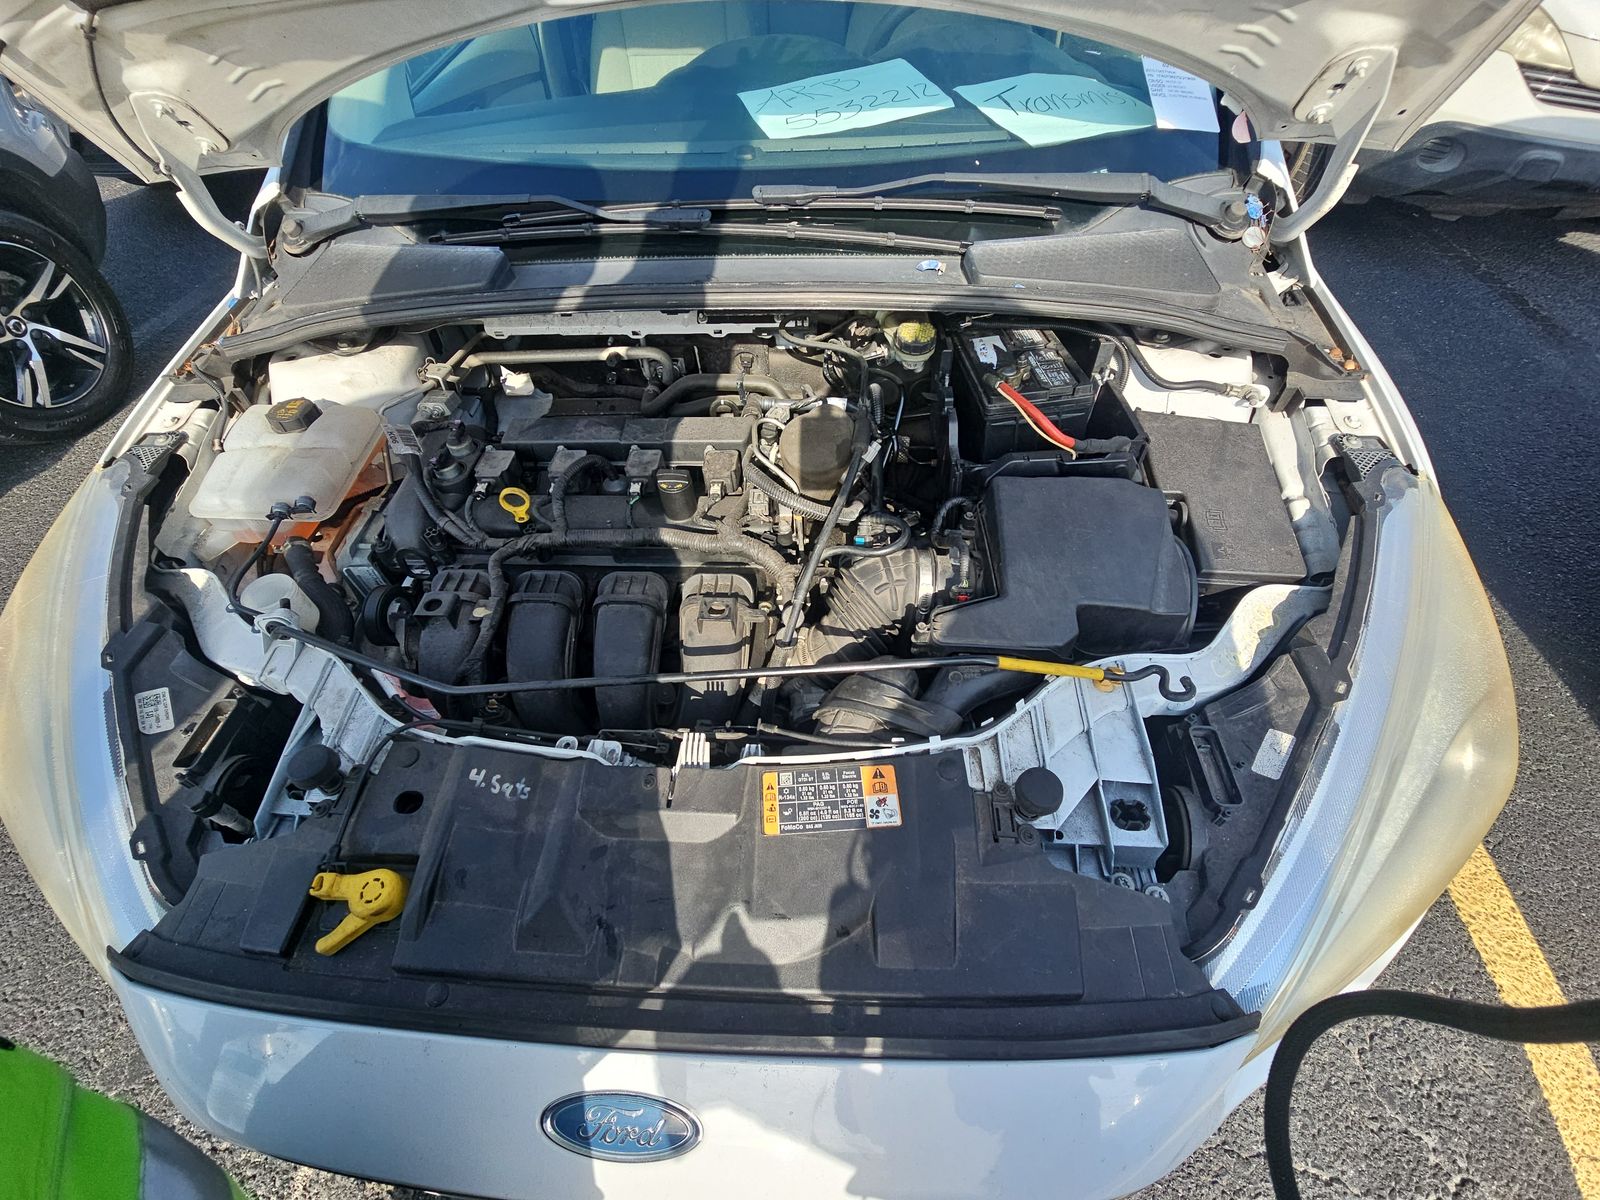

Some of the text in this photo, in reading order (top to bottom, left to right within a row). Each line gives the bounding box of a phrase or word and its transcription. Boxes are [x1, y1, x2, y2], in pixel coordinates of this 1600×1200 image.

[785, 82, 940, 130] 5532212
[780, 823, 804, 831] FoMoCo
[576, 1104, 667, 1147] Ford
